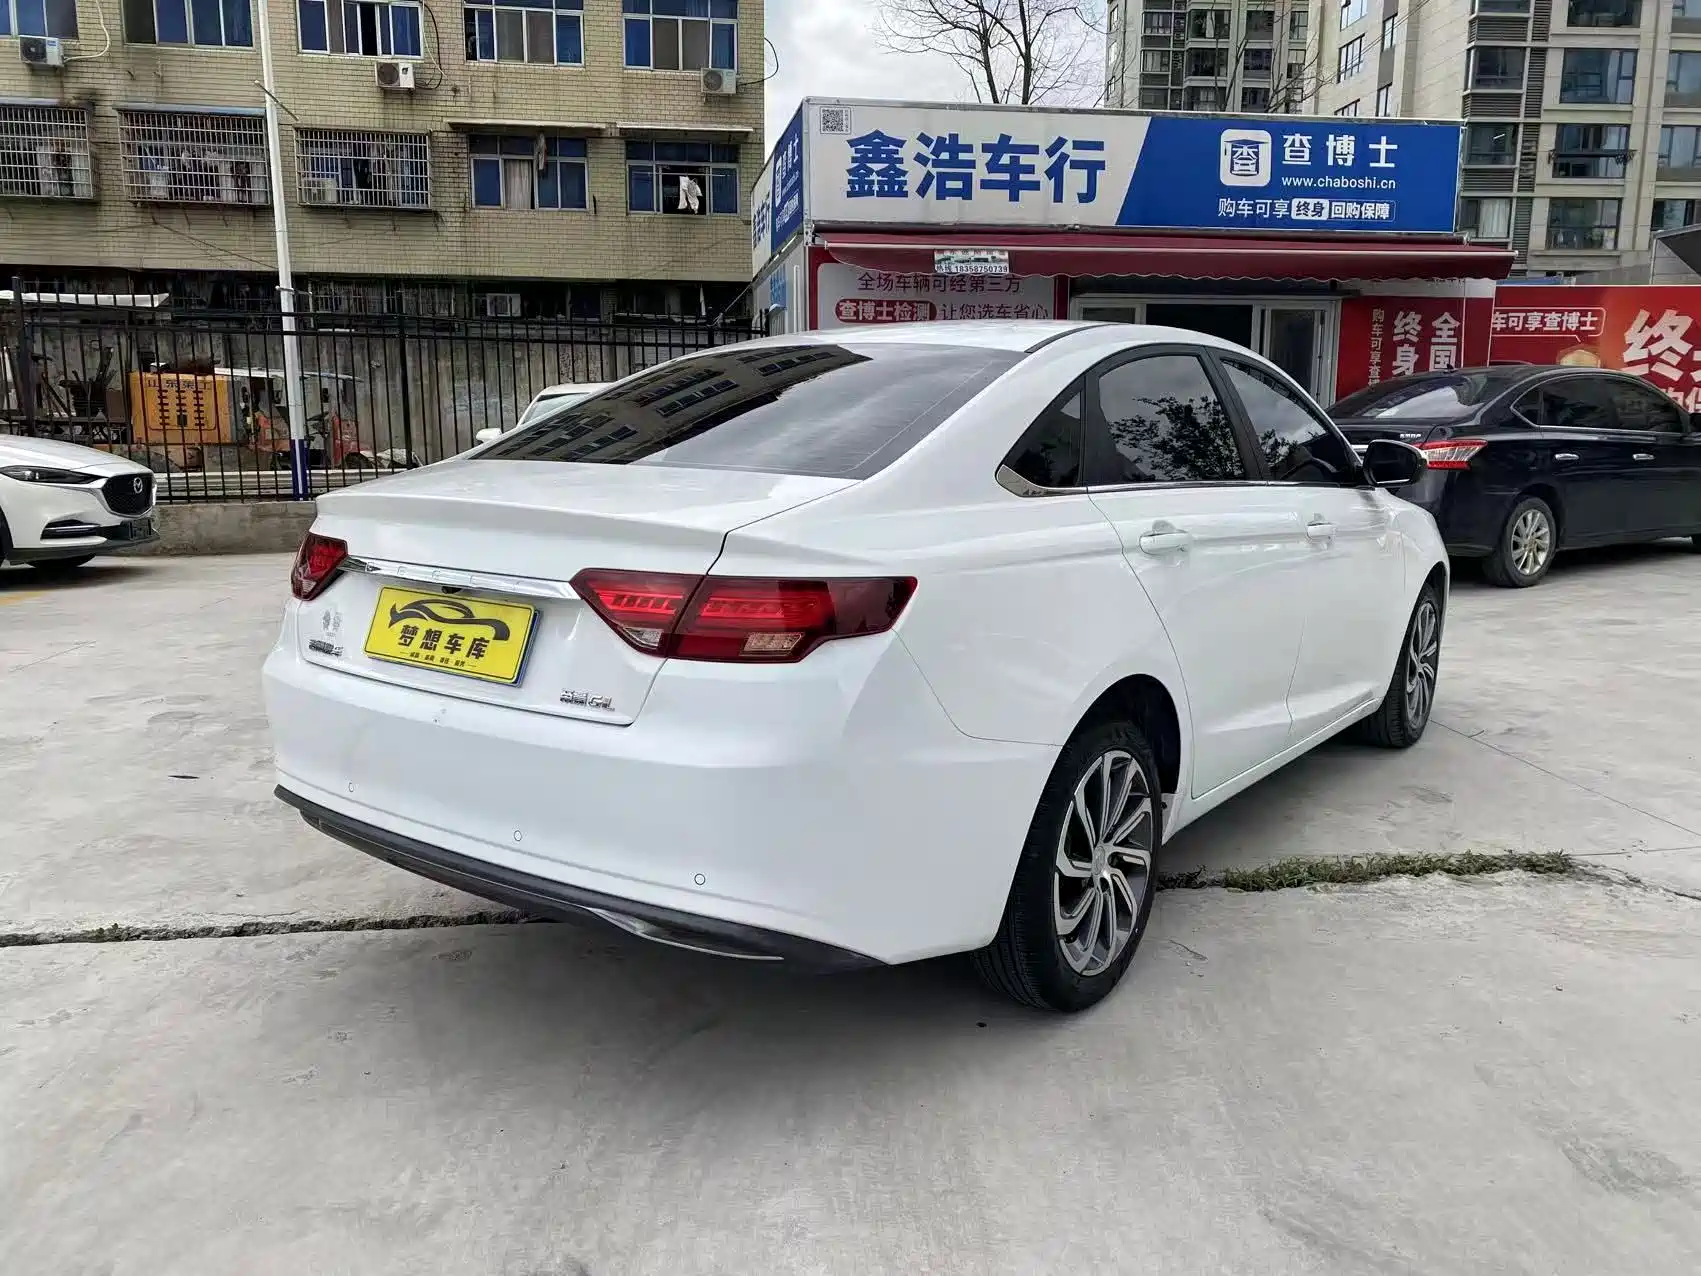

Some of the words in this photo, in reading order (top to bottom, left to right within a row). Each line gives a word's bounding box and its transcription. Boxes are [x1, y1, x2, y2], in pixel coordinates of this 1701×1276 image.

[846, 128, 1105, 203] 鑫浩车行
[1282, 133, 1398, 168] 查博士
[1282, 175, 1396, 190] www.chaboshi.cn
[857, 271, 1022, 294] 全场车辆可经第三方
[838, 300, 931, 321] 查博士检测
[1391, 311, 1423, 376] 终身
[1429, 311, 1461, 371] 全国
[1621, 308, 1701, 382] 终
[398, 624, 490, 659] 梦想车库
